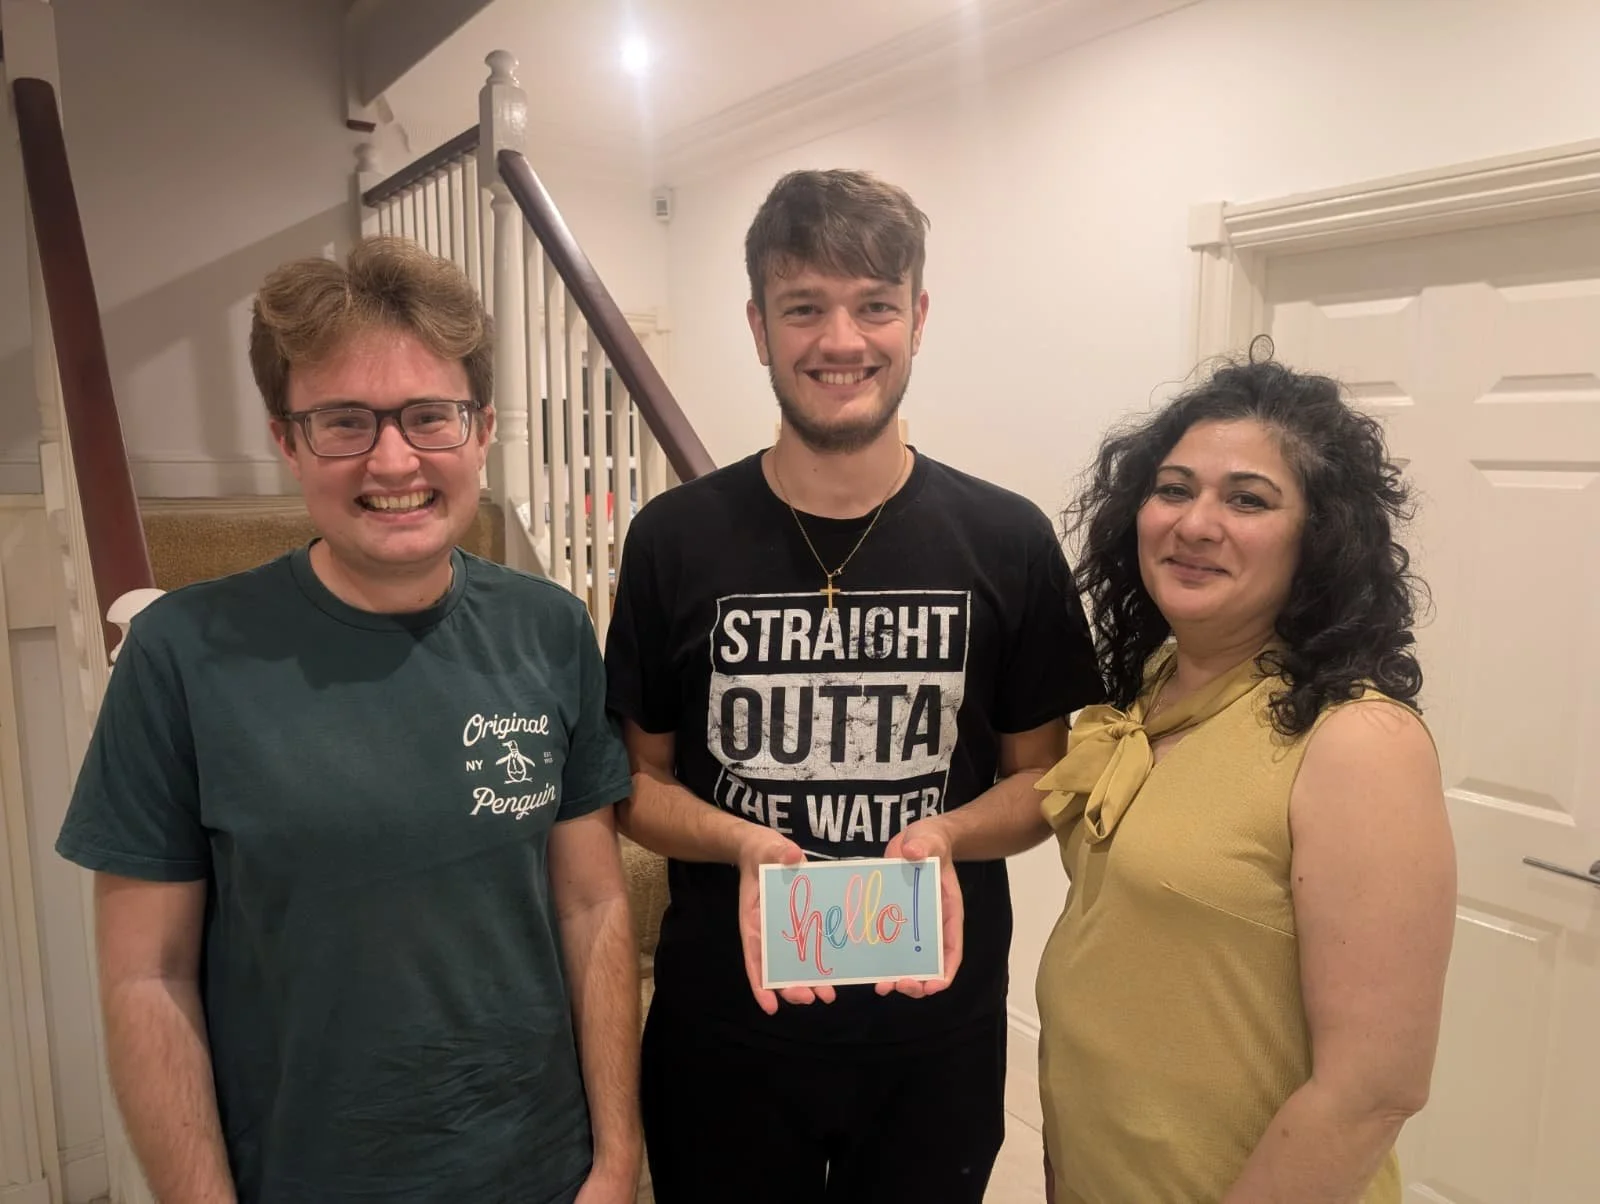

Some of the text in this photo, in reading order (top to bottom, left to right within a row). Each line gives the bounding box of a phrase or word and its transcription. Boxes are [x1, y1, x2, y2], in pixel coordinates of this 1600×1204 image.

[720, 606, 959, 663] STRAIGHT
[463, 711, 549, 747] Original
[720, 684, 941, 764] OUTTA
[465, 760, 483, 771] NY
[470, 782, 555, 820] Penguin
[725, 773, 793, 834] THE
[782, 867, 921, 976] hello!
